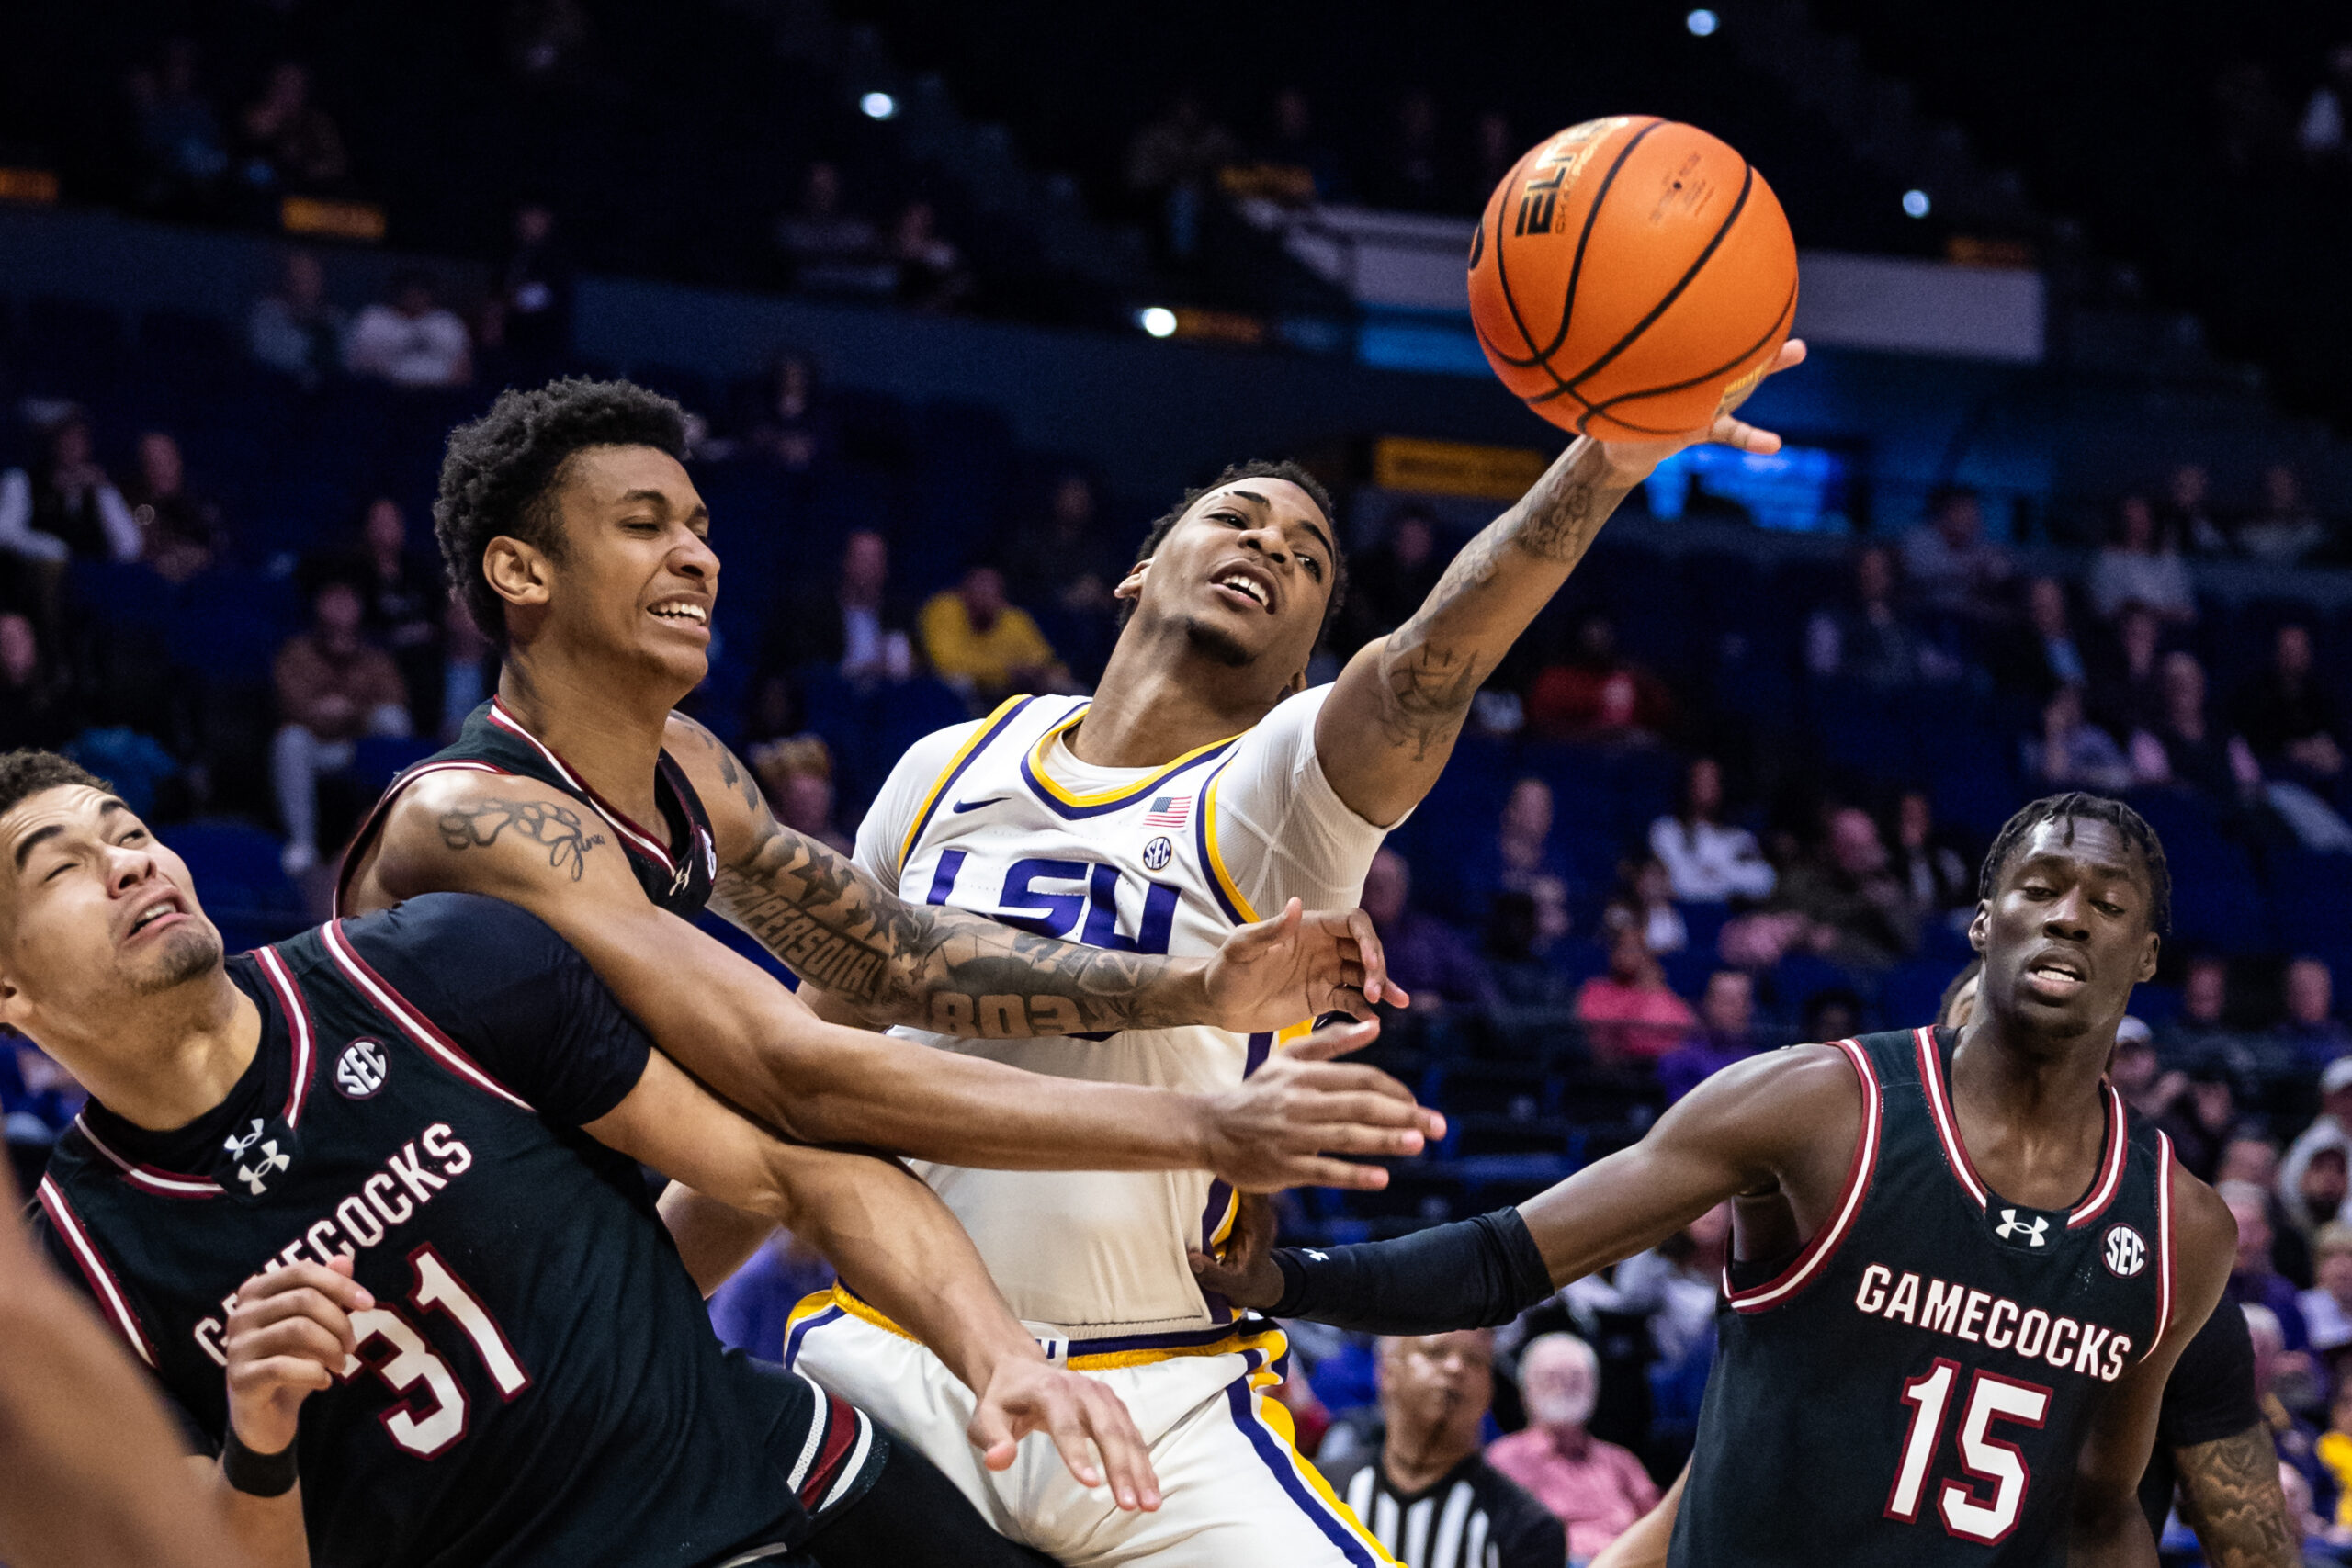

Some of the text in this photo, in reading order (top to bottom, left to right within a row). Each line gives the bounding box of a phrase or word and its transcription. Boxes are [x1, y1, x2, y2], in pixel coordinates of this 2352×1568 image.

[927, 849, 1182, 954] LSU
[1144, 837, 1171, 869] SEC
[741, 896, 887, 999] PERSONAL
[931, 992, 1091, 1039] 803
[336, 1041, 387, 1096] SEC
[193, 1122, 473, 1368] GCOCKS
[2105, 1225, 2146, 1276] SEC
[334, 1242, 533, 1461] 31
[1854, 1263, 2132, 1382] GAMECOCKS
[1884, 1357, 2053, 1546] 15
